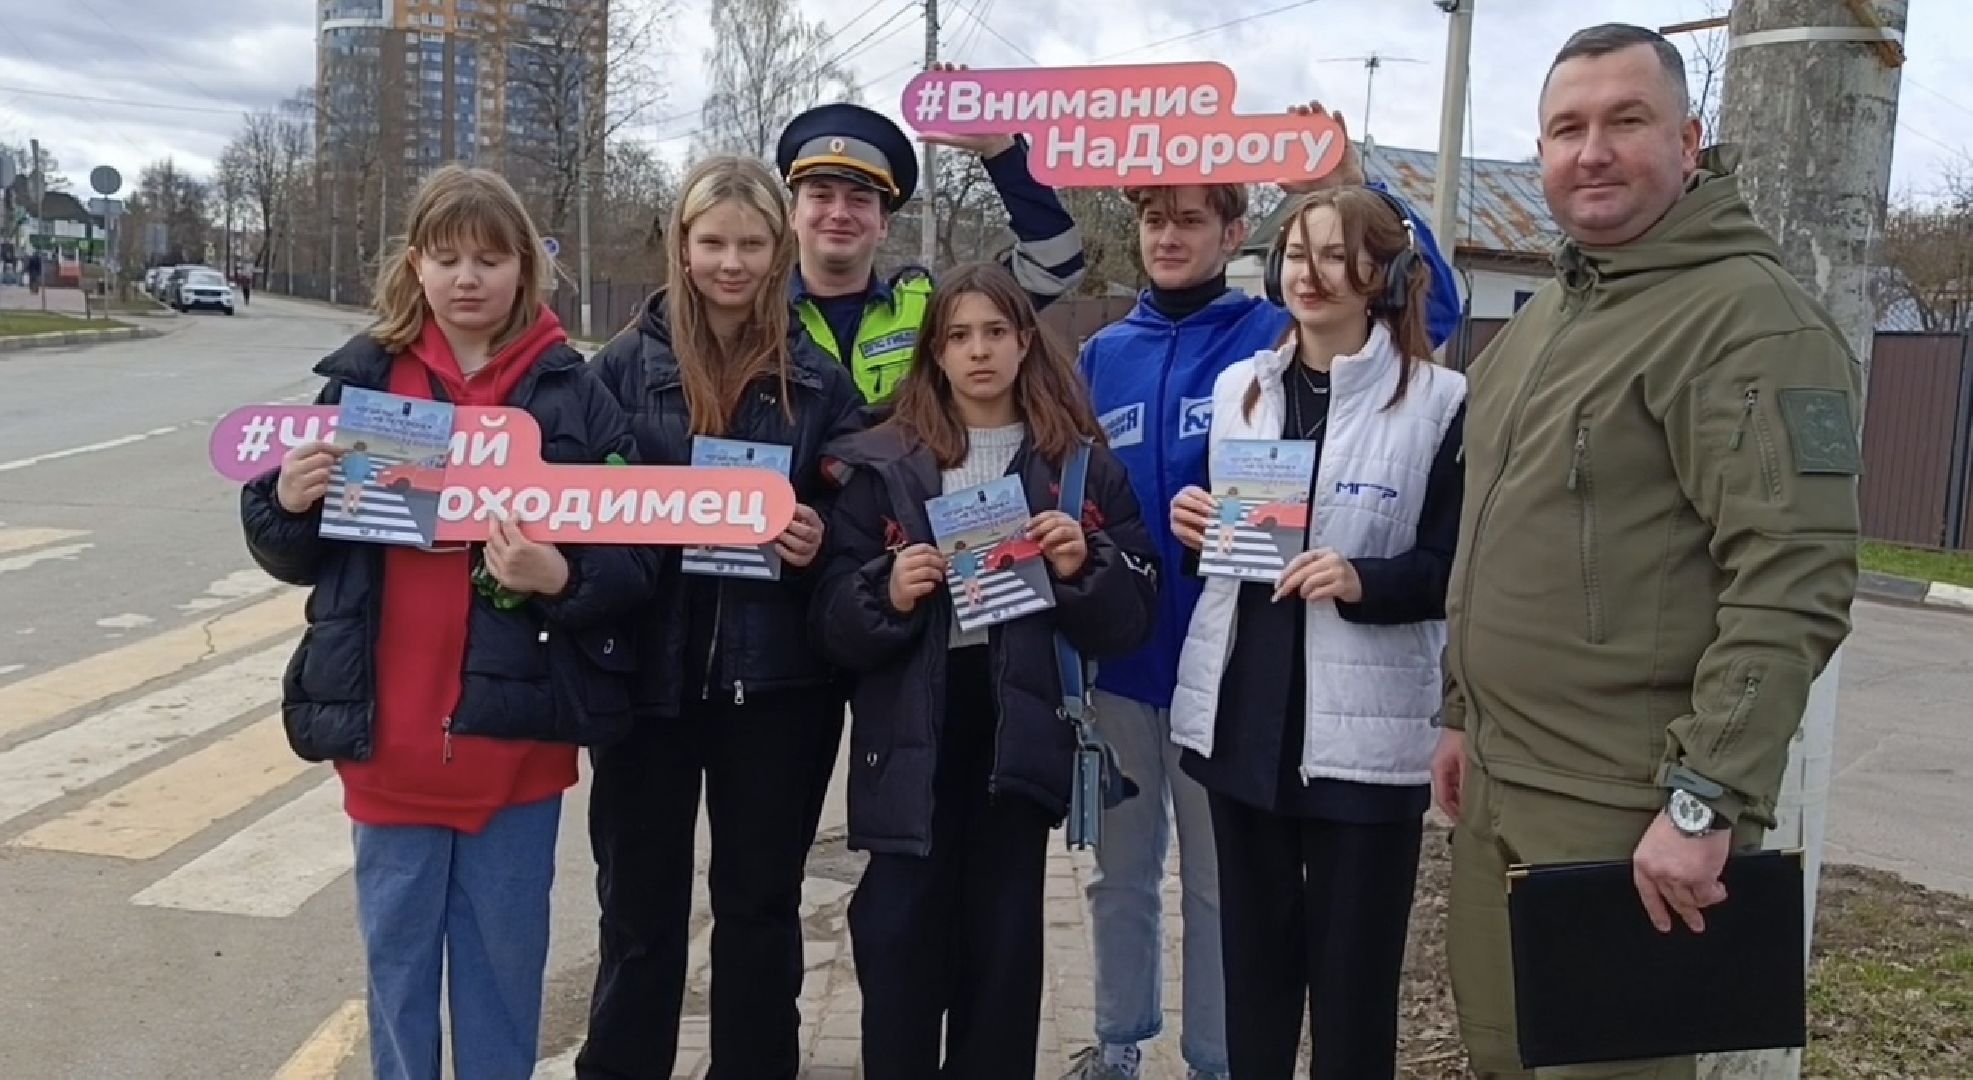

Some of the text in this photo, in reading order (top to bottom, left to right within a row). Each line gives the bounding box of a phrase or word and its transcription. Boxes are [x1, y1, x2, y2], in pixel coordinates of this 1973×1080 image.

[915, 80, 1218, 122] #Внимание
[1046, 124, 1334, 176] НаДорогу
[437, 486, 767, 534] оходимец
